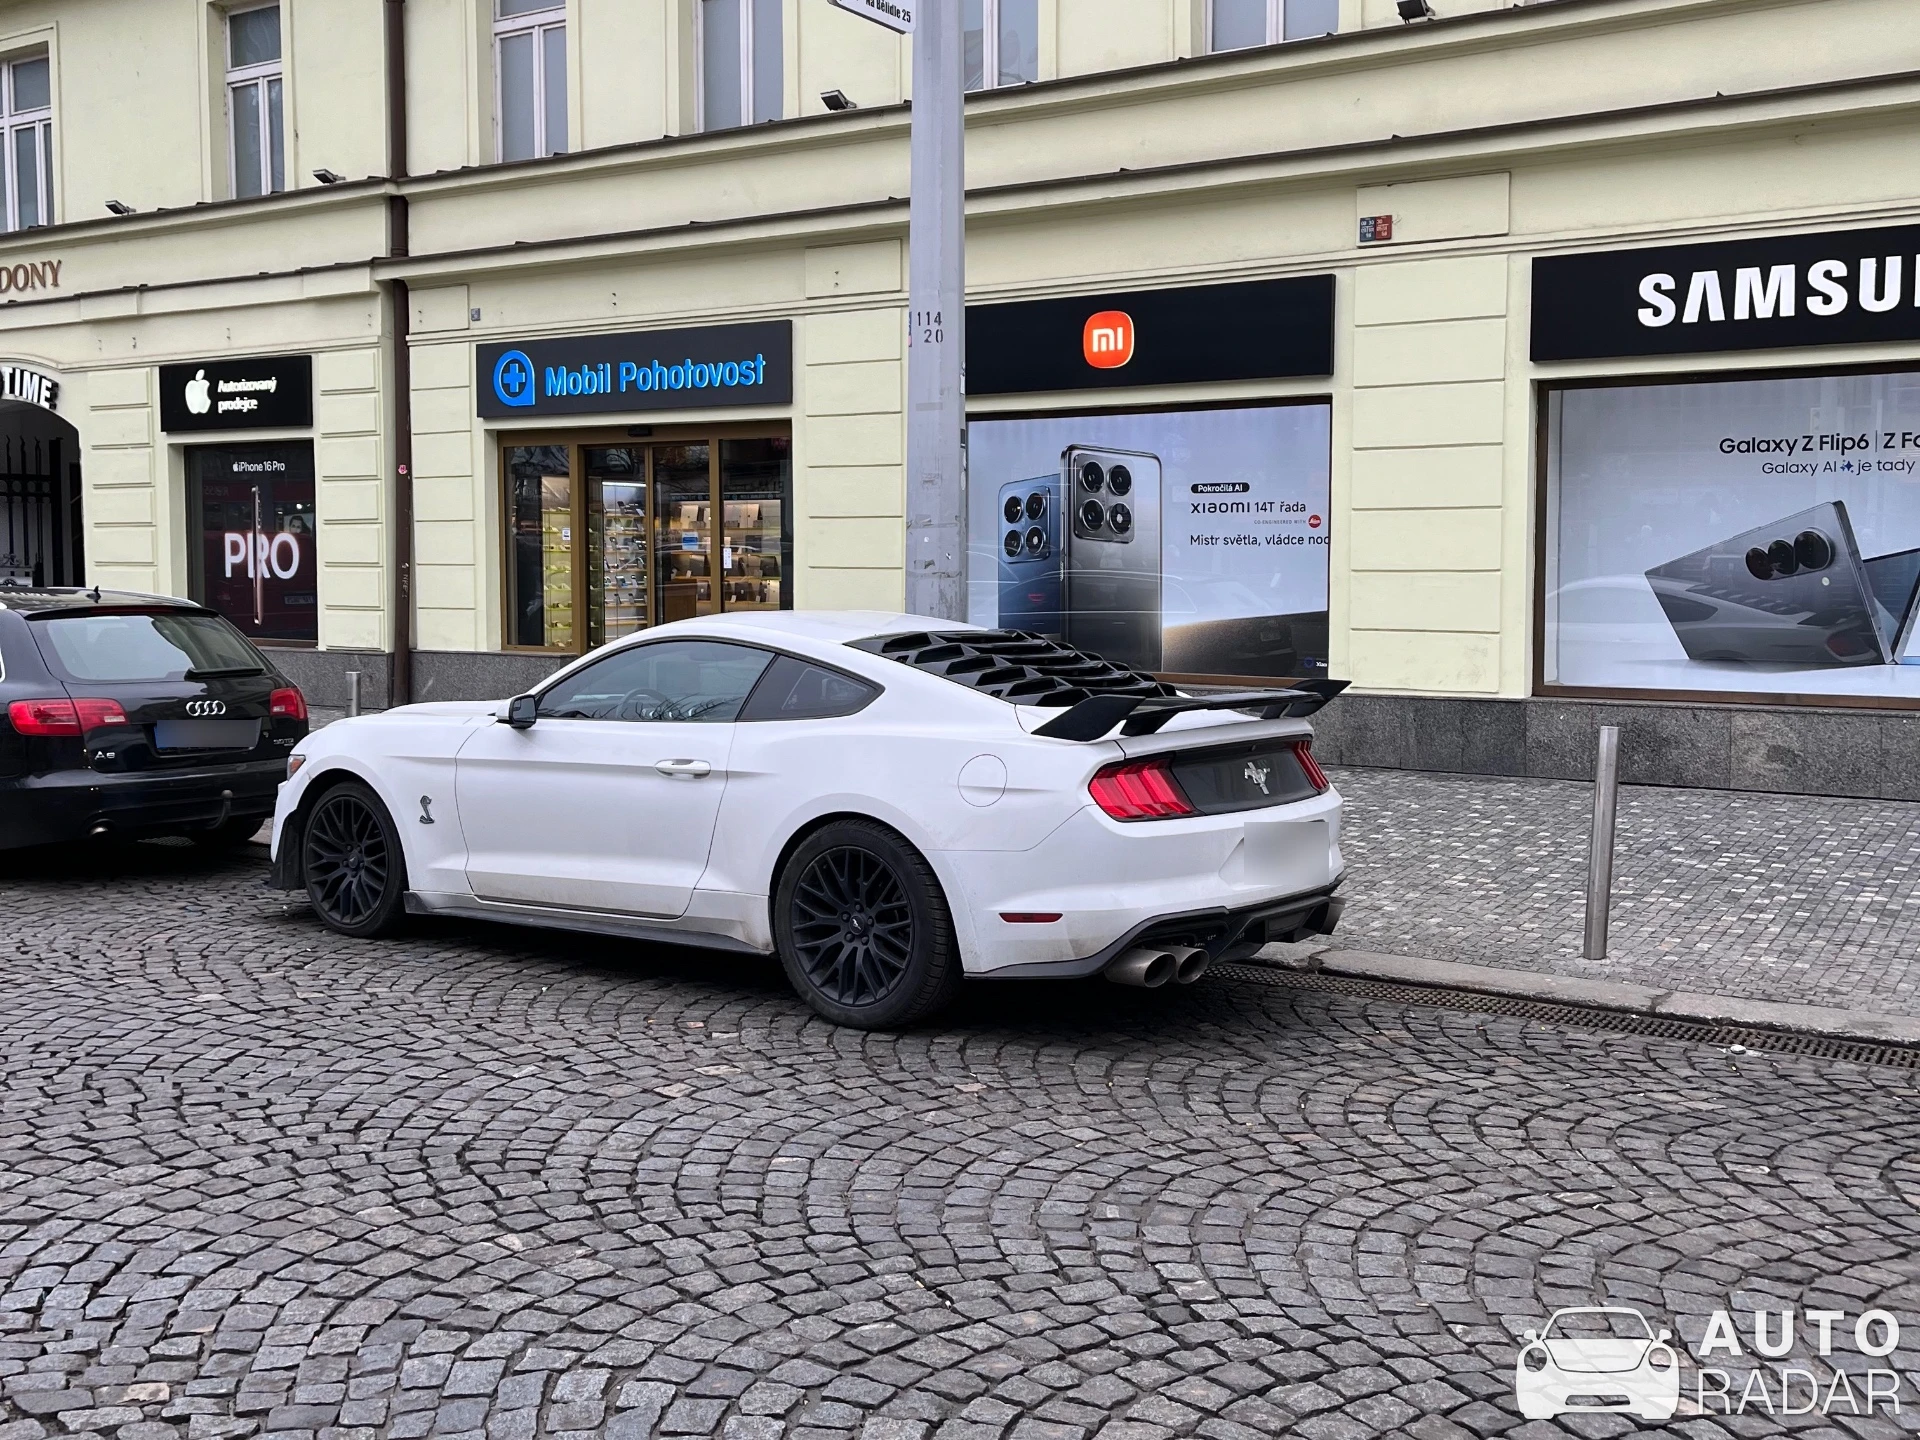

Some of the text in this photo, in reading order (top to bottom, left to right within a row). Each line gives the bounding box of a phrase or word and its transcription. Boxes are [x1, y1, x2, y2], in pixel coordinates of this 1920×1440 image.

[902, 9, 912, 23] 25
[1638, 254, 1920, 327] SAMSU
[917, 311, 942, 326] 114
[923, 329, 944, 343] 20
[545, 353, 766, 397] Mobil Pohotovost
[1, 366, 53, 410] TIME
[217, 376, 277, 393] Autorizovaný
[217, 397, 259, 414] prodejce
[1719, 437, 1798, 456] Galaxy
[1801, 435, 1814, 452] Z
[1819, 433, 1870, 456] Flip6
[1883, 432, 1896, 449] Z
[238, 461, 286, 472] iPhone 16 Pro
[1762, 459, 1916, 477] Galaxy AI je tady
[1197, 483, 1243, 493] Pokročilá AI
[1254, 501, 1276, 513] 14T
[1280, 501, 1307, 513] řada
[1190, 535, 1220, 546] Mistr
[1223, 534, 1262, 547] světla,
[1265, 533, 1305, 546] vládce
